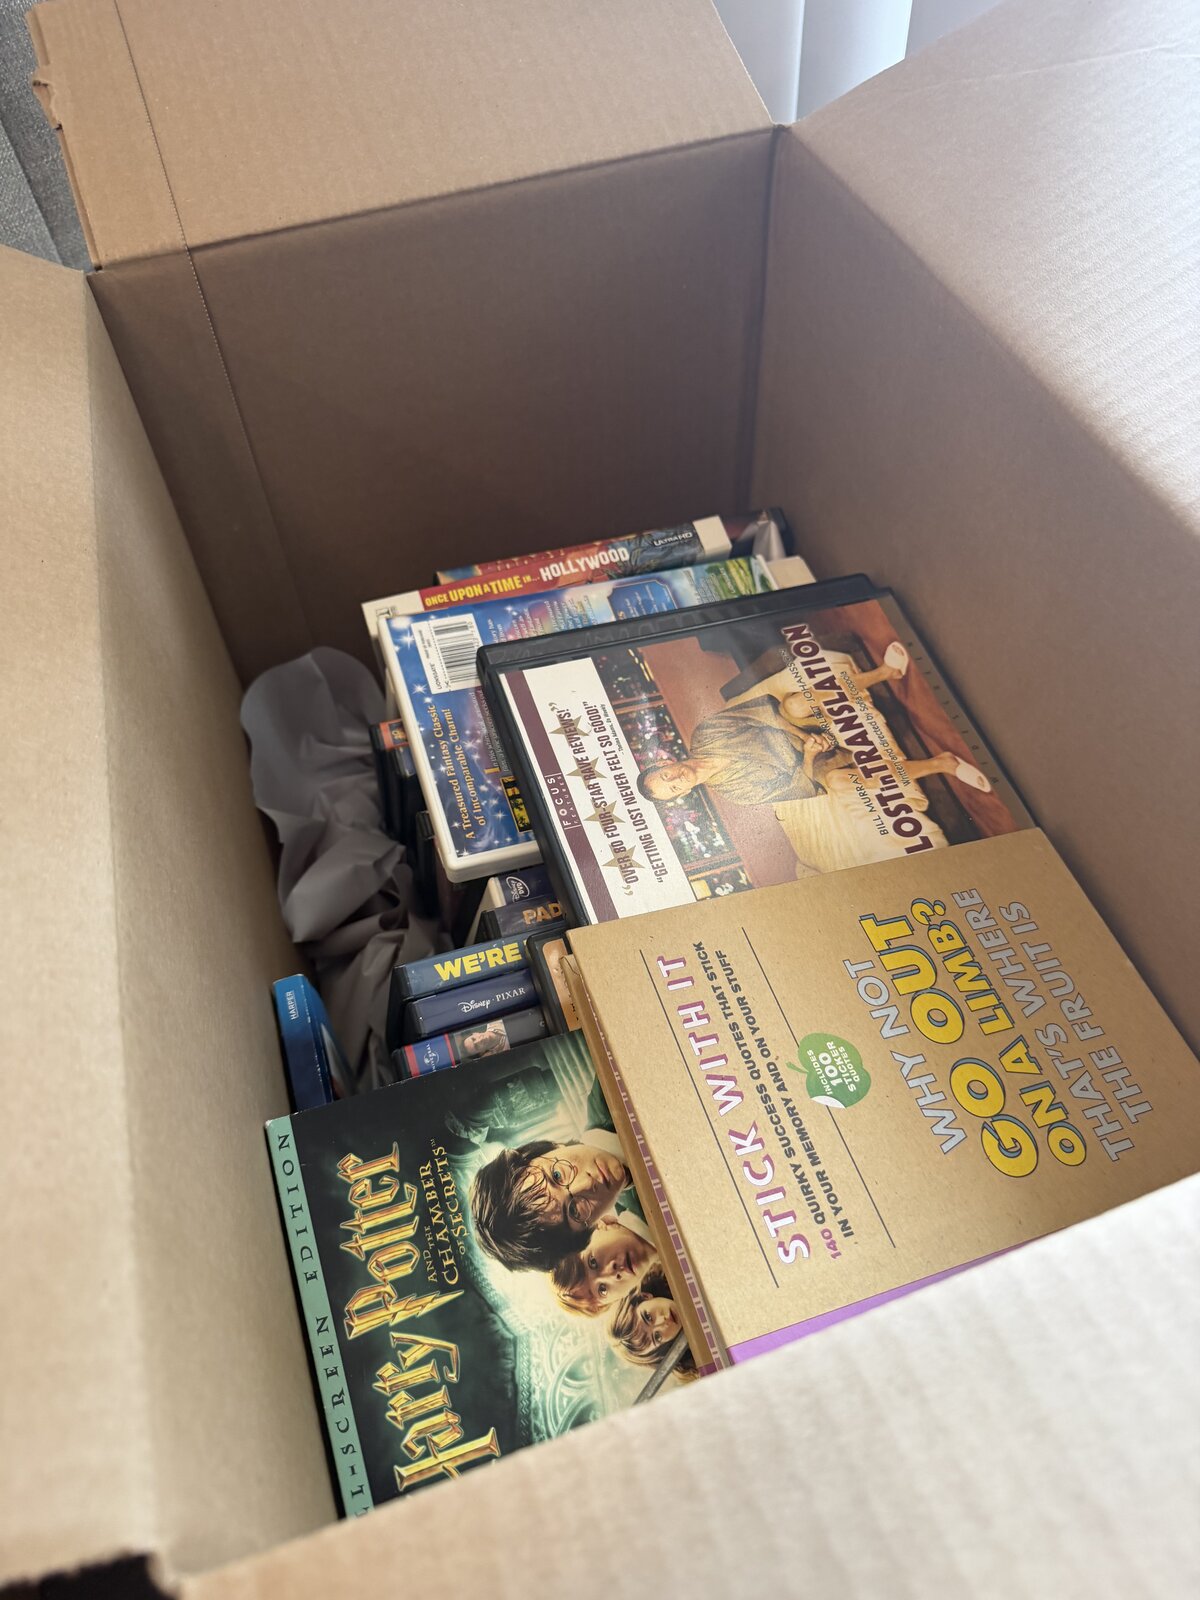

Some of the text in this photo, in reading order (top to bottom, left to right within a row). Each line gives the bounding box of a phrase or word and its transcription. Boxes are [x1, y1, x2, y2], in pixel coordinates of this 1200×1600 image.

[425, 594, 449, 608] ONCE
[448, 586, 484, 602] UPON
[483, 584, 490, 594] A
[489, 575, 523, 596] TIME
[539, 547, 630, 582] HOLLYWOOD
[779, 647, 815, 702] JOHANSSON
[597, 735, 613, 748] SO
[781, 623, 934, 855] LOST in TRANSLATION
[840, 671, 911, 787] Written and directed by Sofia Coppola
[427, 704, 476, 839] A Treasured Fantasy Classic
[442, 708, 486, 826] of Incomparable Charm!
[577, 756, 597, 781] RAVE
[603, 750, 623, 772] FELT
[613, 772, 638, 806] NEVER
[547, 777, 572, 826] FOCUS
[557, 776, 578, 824] FEATURES
[587, 782, 620, 839] FOUR-STAR
[627, 808, 648, 832] LOST
[847, 773, 889, 836] BILL MURRAY
[610, 840, 627, 854] 80
[516, 882, 525, 895] DVD
[434, 942, 522, 982] WE'RE
[285, 989, 300, 1020] HARPER
[457, 987, 526, 1014] Disney PIXAR
[951, 888, 1135, 1162] THAT'S WHERE
[999, 902, 1153, 1124] THE FRUIT IS
[843, 959, 968, 1155] WHY NOT
[858, 913, 1039, 1178] GO OUT
[910, 897, 1087, 1167] ON A LIMB?
[806, 1049, 833, 1095] INCLUDES
[818, 1052, 843, 1087] 100
[826, 1041, 857, 1093] STICKER
[838, 1046, 860, 1082] QUOTES
[656, 955, 811, 1264] STICK WITH IT
[693, 940, 842, 1259] 140 QUIRKY SUCCESS QUOTES THAT STICK
[715, 950, 855, 1238] IN YOUR MEMORY AND ON YOUR STUFF
[278, 1133, 319, 1284] EDITION
[419, 1160, 459, 1285] CHAMBER
[337, 1141, 464, 1340] Potter
[423, 1225, 438, 1283] AND THE
[456, 1240, 466, 1256] OF
